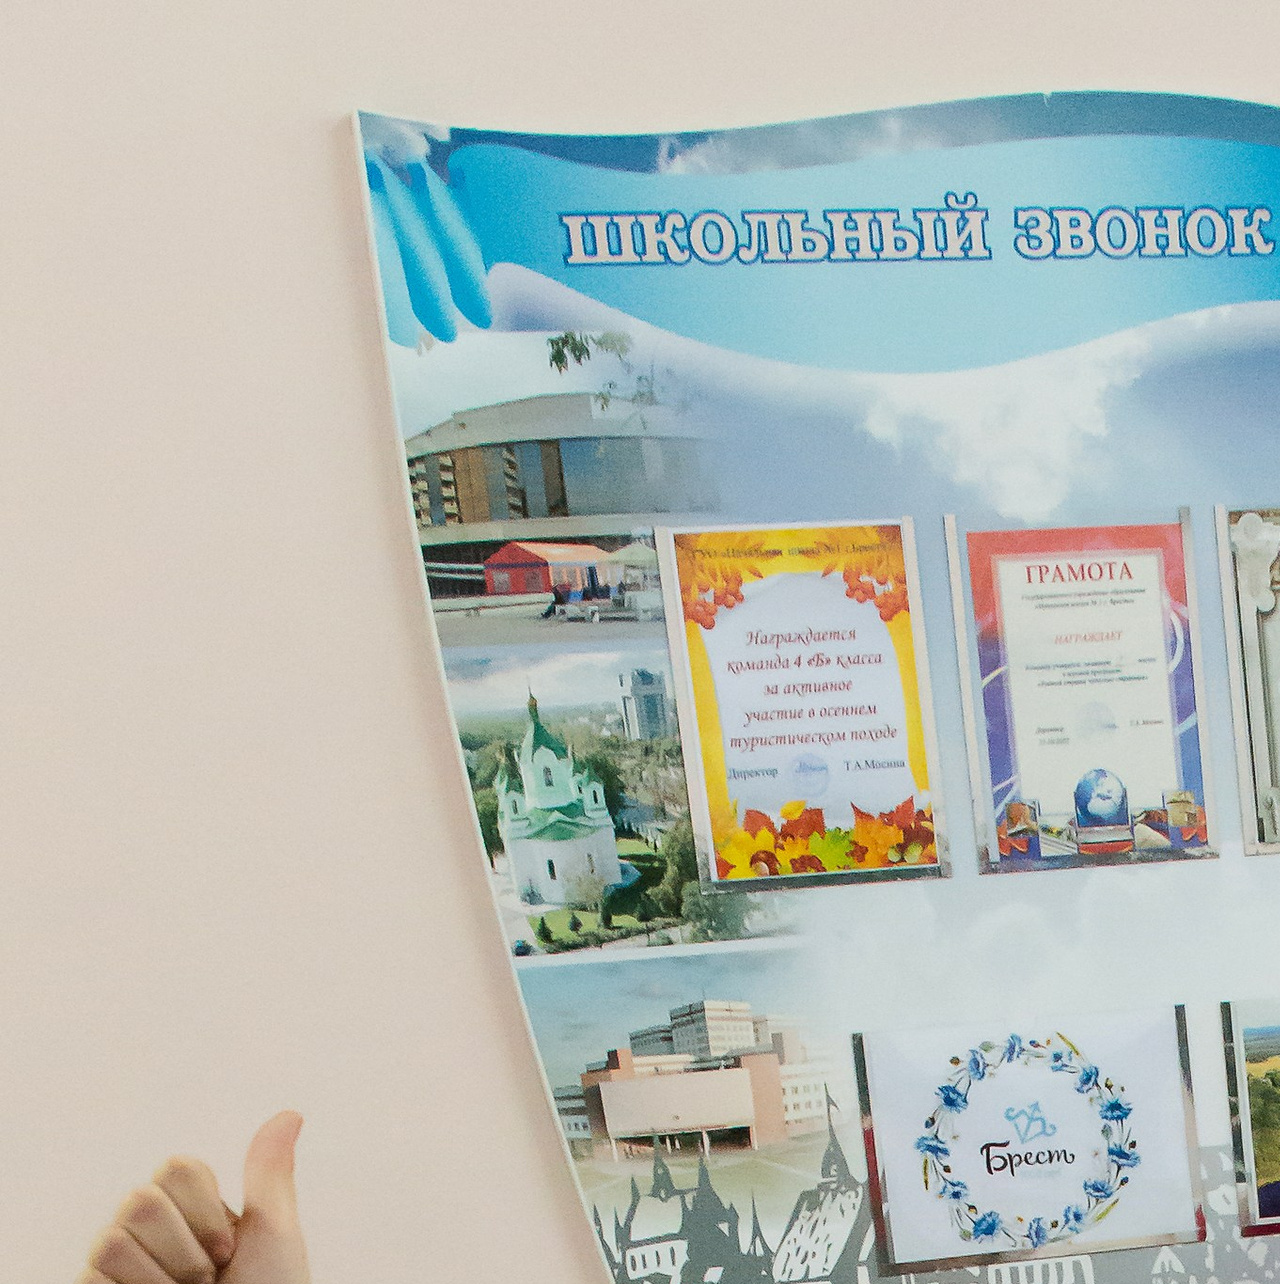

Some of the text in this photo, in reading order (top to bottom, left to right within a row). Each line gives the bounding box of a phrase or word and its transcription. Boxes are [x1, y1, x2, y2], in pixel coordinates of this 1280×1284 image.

[558, 191, 1277, 266] ШКОЛЬНЫЙ ЗВОНОК
[1024, 560, 1135, 585] ГРАМОТА
[746, 627, 857, 649] Награждается
[727, 653, 790, 675] команда
[793, 654, 802, 669] 4
[836, 652, 883, 669] класса
[764, 679, 853, 698] за активное
[743, 704, 877, 727] участие в осеннем
[730, 724, 898, 753] туристическом походе
[728, 766, 779, 781] Директор
